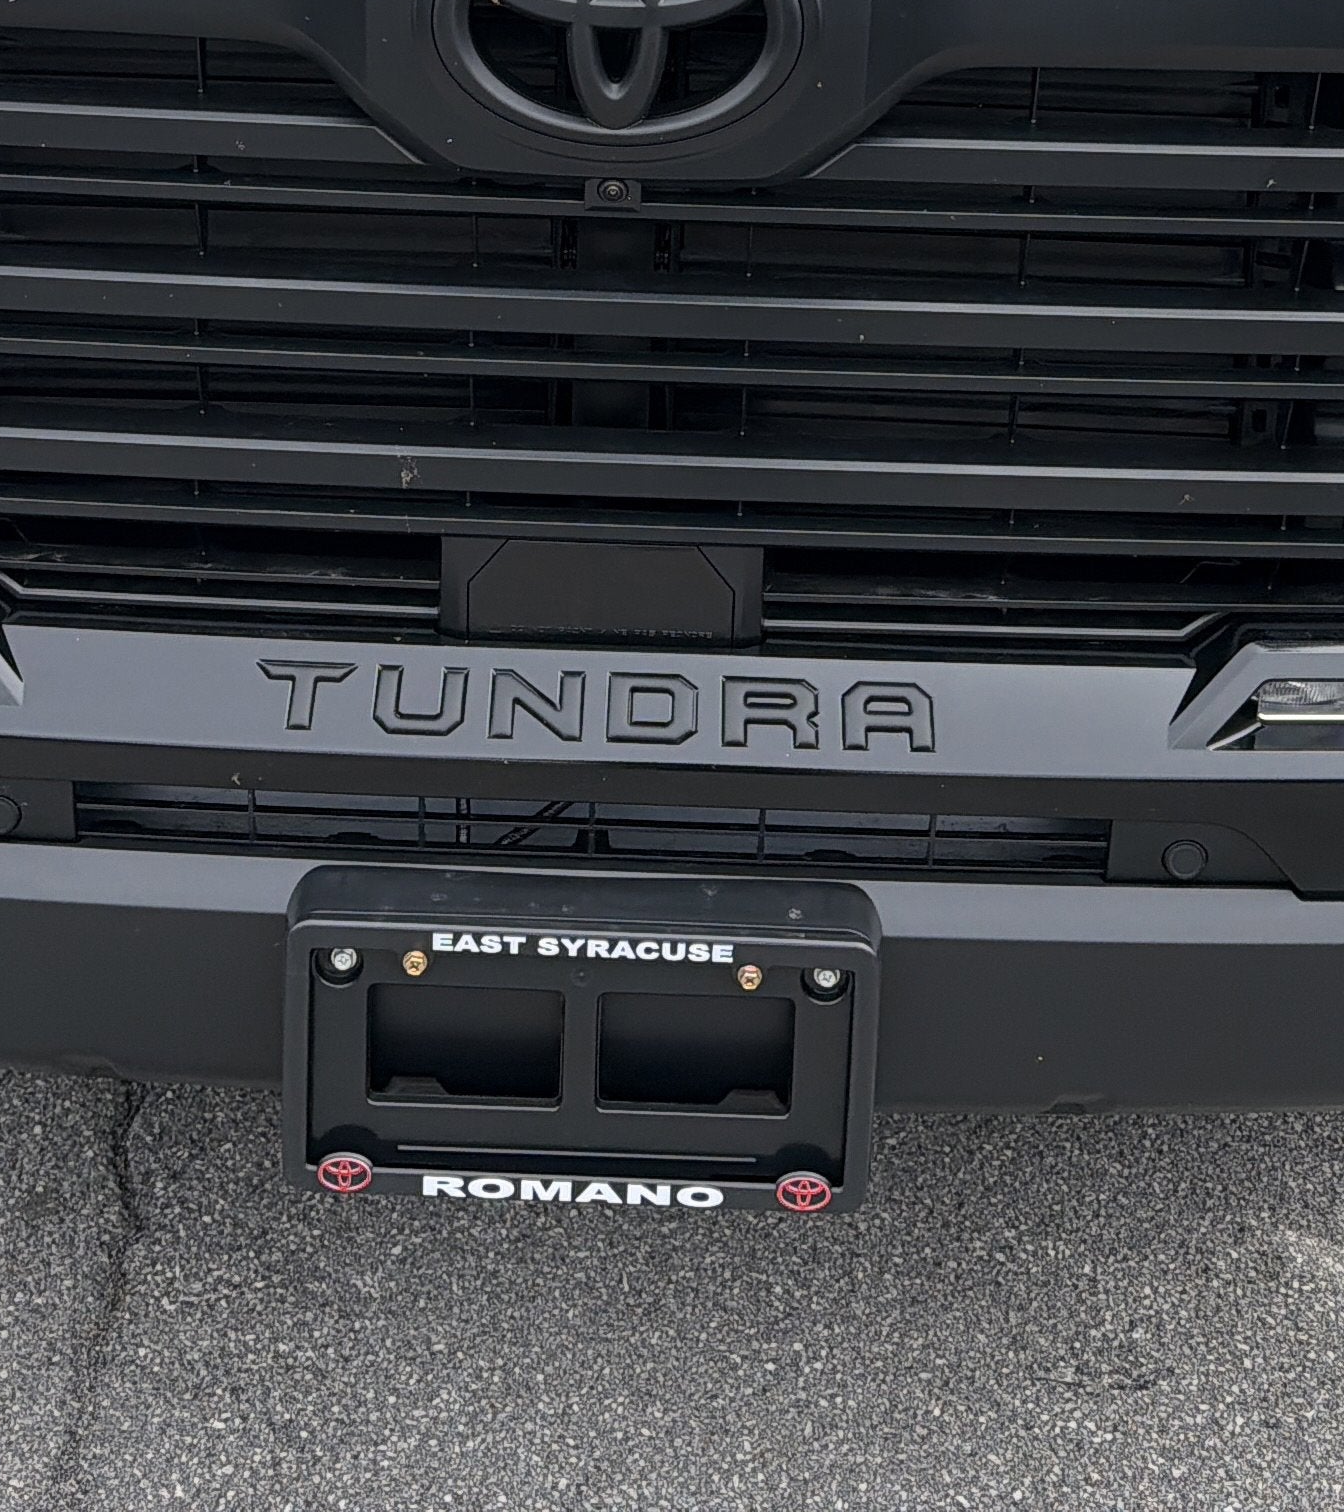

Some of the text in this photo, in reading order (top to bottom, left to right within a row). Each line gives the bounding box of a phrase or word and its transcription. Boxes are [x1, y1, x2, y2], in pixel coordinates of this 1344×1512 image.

[255, 658, 937, 754] TUNDRA
[431, 932, 735, 964] EAST SYRACUSE
[421, 1174, 725, 1208] ROMANO
